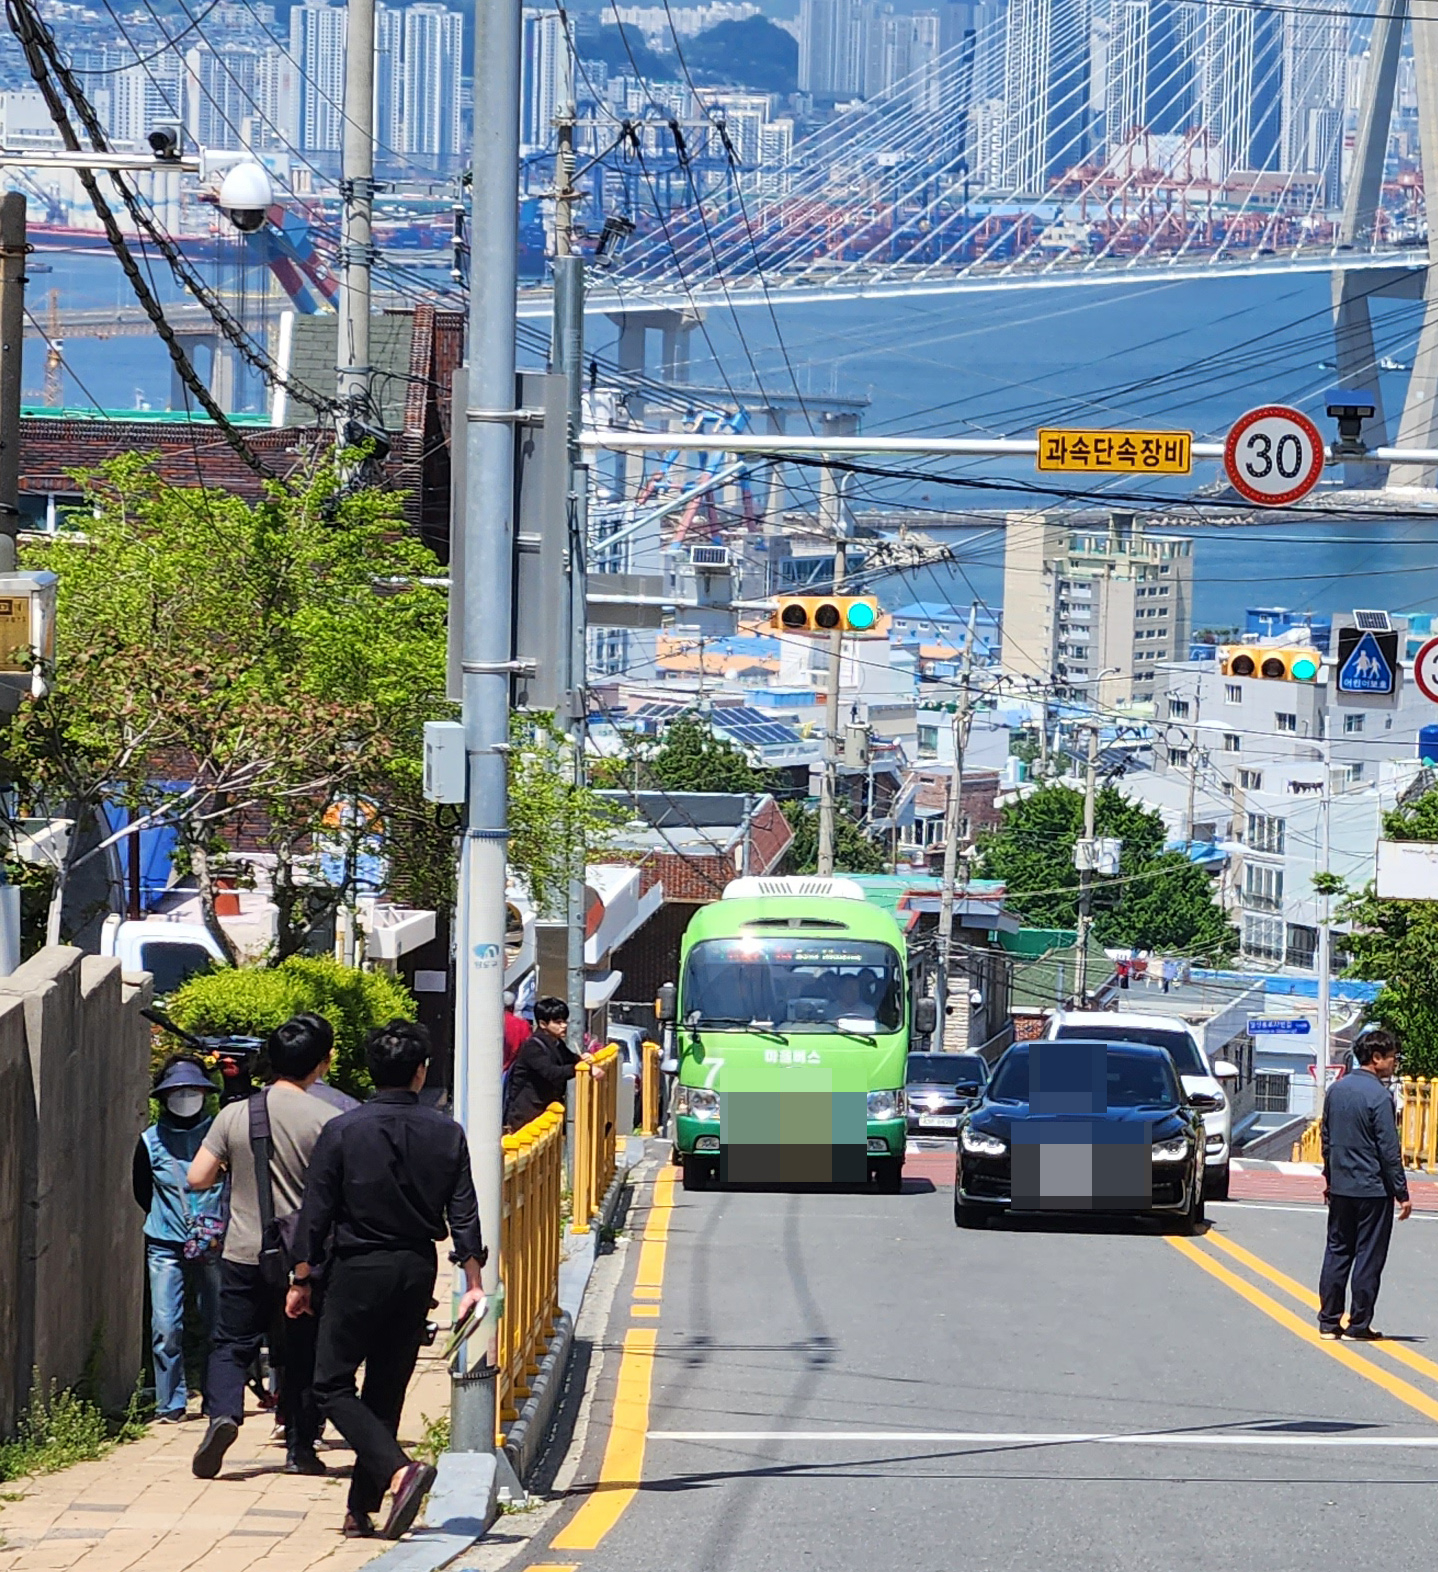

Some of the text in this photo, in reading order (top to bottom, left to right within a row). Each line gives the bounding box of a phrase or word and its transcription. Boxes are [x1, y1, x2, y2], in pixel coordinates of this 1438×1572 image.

[1045, 437, 1184, 468] 과속단속장비
[1246, 433, 1303, 479] 30
[701, 1057, 725, 1089] 7
